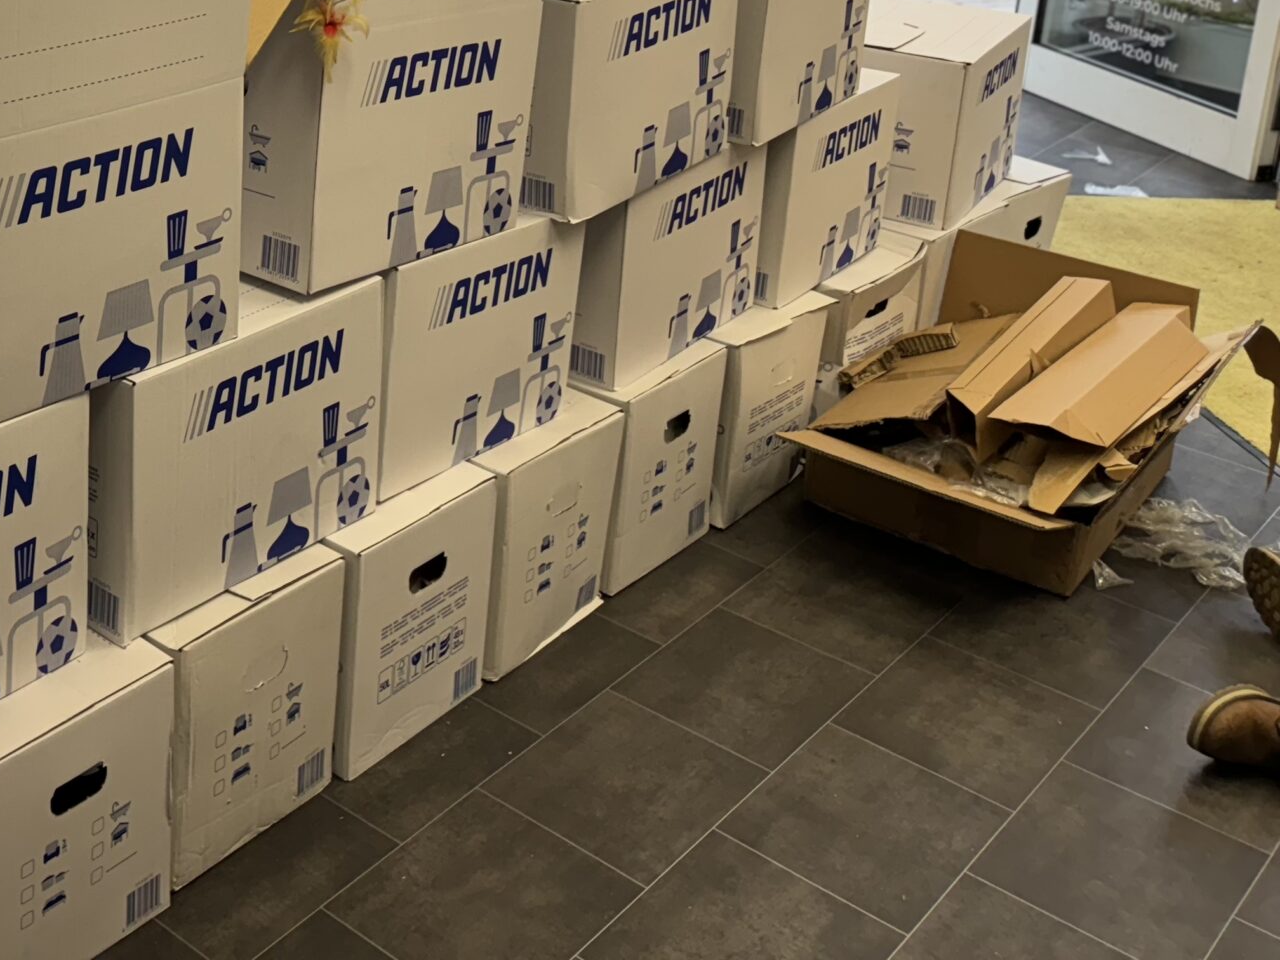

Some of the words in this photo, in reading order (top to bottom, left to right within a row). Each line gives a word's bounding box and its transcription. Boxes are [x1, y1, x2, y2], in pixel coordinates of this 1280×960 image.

[1105, 16, 1167, 49] Samstags
[1162, 7, 1189, 25] Uhr
[380, 40, 501, 103] ACTION
[981, 47, 1020, 102] ACTION
[1154, 54, 1180, 75] Uhr
[823, 109, 883, 169] ACTION
[17, 127, 195, 227] ACTION
[668, 161, 749, 229] ACTION
[446, 248, 553, 324] ACTION
[206, 329, 345, 432] ACTION
